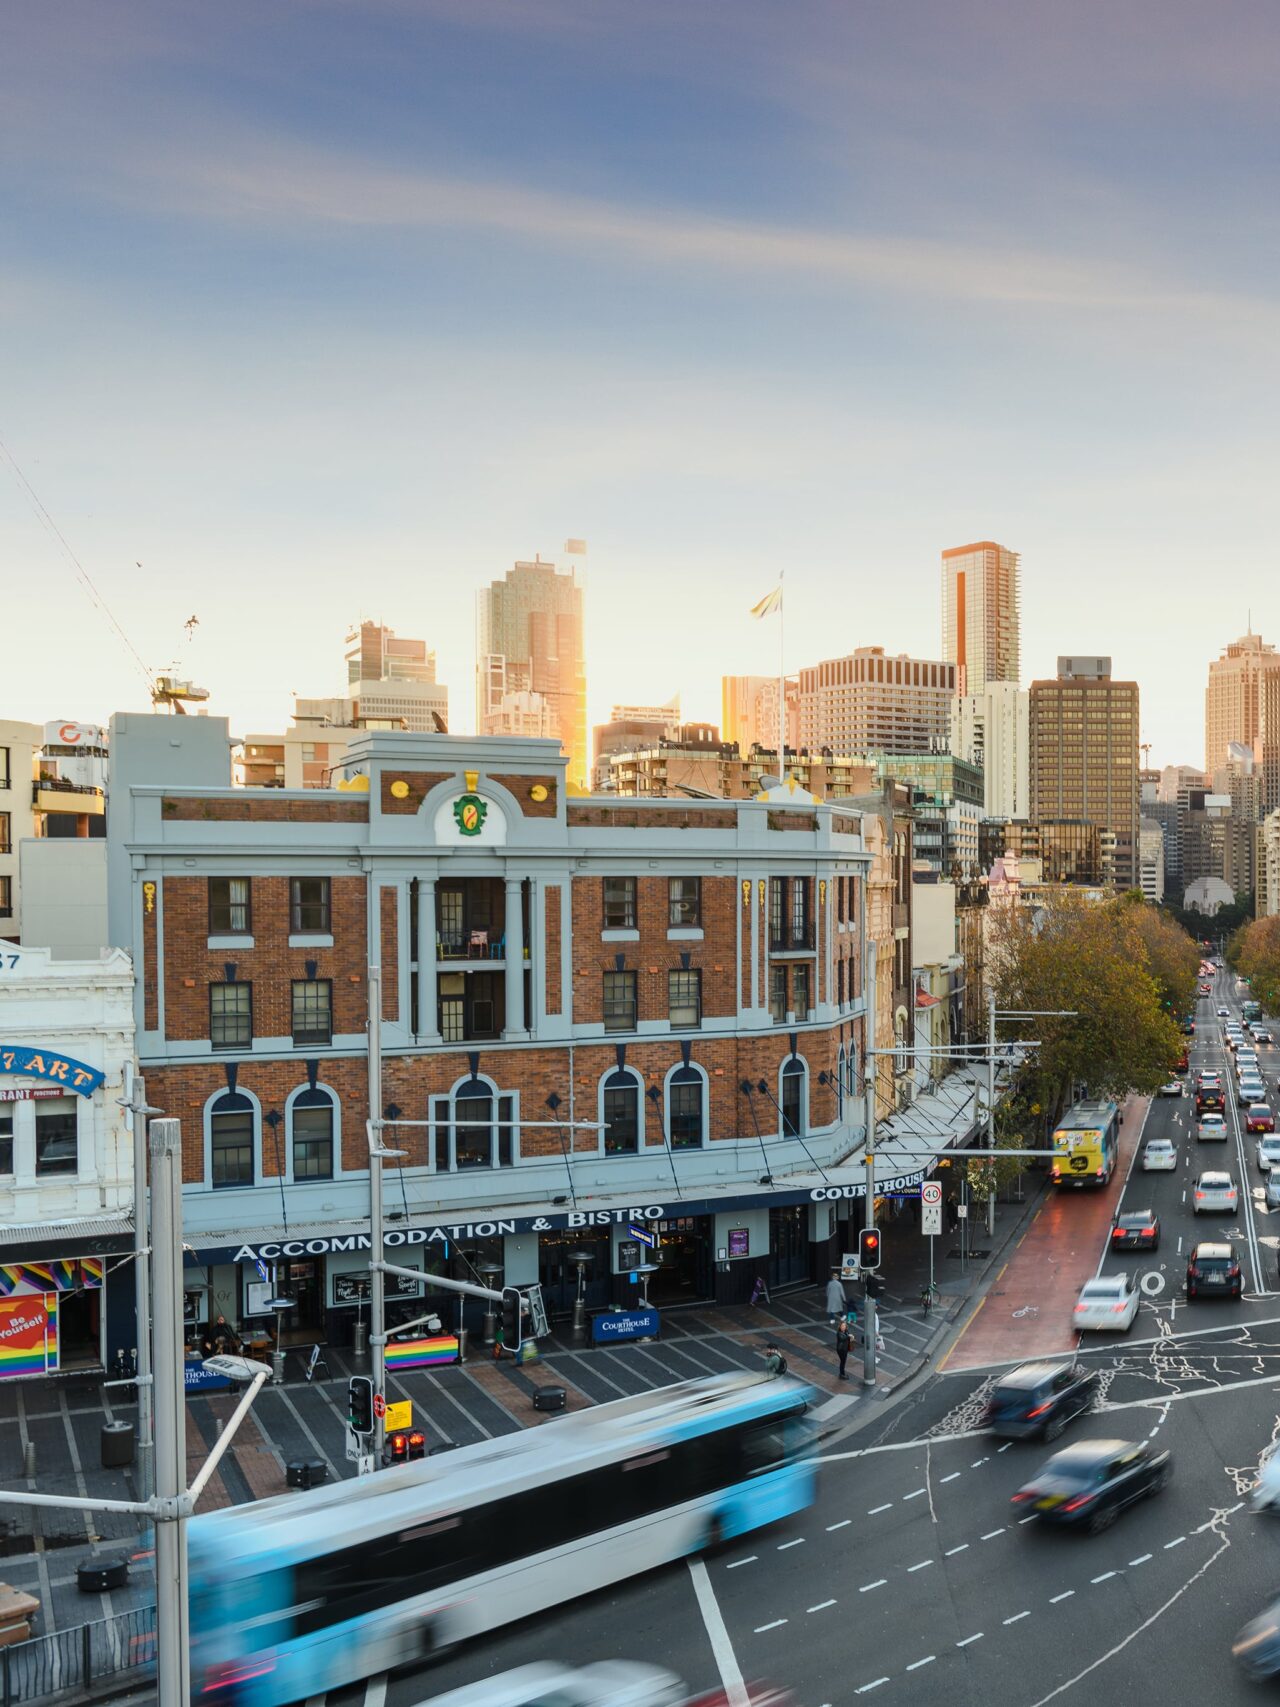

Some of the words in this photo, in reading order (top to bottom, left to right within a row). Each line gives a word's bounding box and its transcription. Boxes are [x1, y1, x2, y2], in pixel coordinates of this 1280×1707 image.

[0, 953, 20, 969] 7
[24, 1055, 94, 1087] ART
[925, 1190, 938, 1198] 40
[532, 1217, 552, 1231] &
[568, 1206, 664, 1228] BISTRO
[0, 1314, 43, 1339] Yourself
[10, 1316, 25, 1327] Be
[347, 1448, 360, 1458] ONLY
